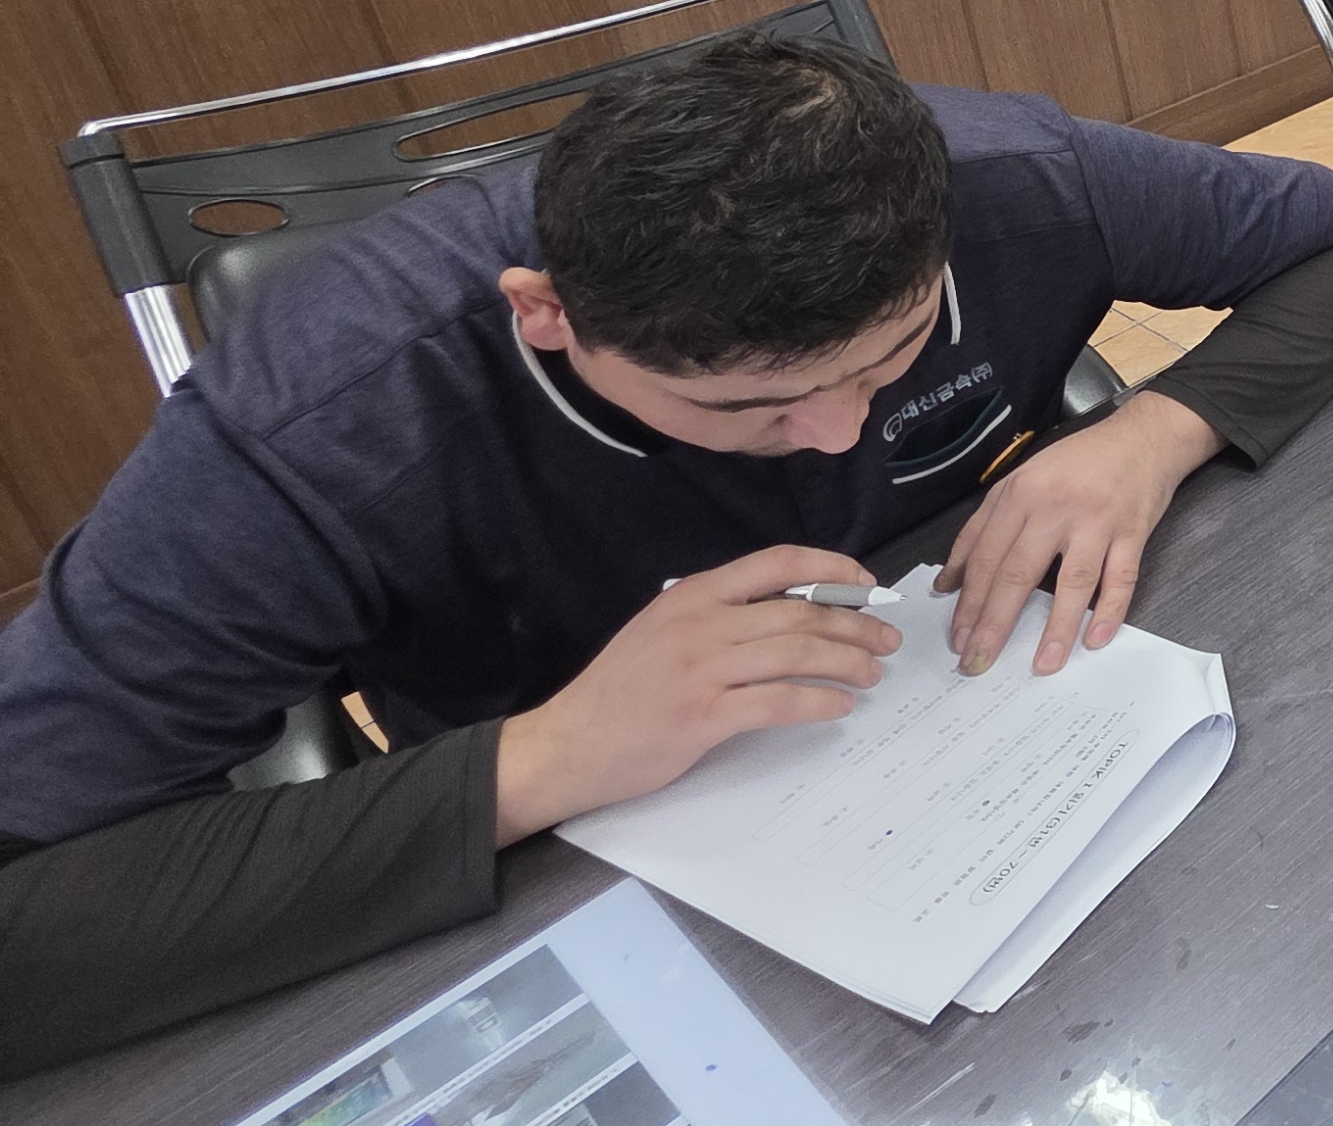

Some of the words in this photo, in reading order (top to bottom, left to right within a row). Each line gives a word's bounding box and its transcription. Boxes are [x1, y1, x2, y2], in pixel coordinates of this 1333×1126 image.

[900, 361, 993, 421] 대신금속(주)
[1090, 739, 1130, 781] TOPIK
[1056, 789, 1084, 817] 읽기
[1026, 814, 1061, 850] (31번
[980, 857, 1019, 895] 70번)
